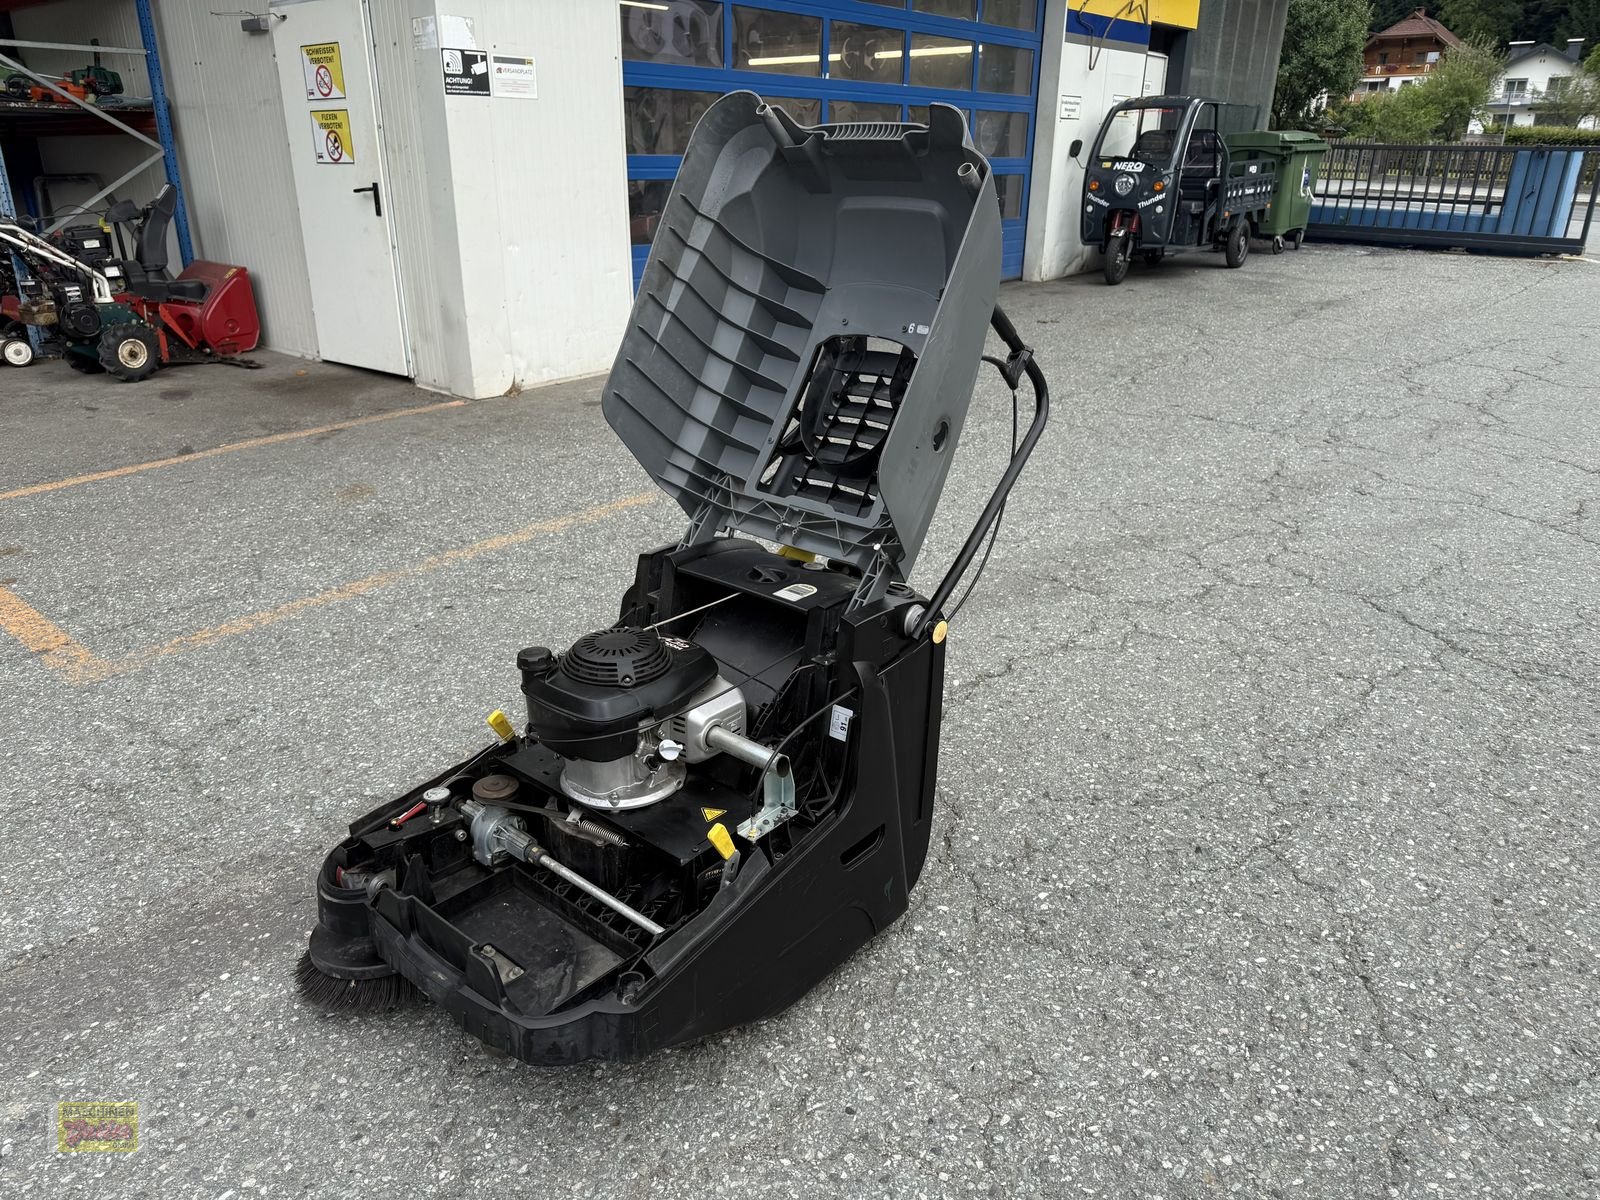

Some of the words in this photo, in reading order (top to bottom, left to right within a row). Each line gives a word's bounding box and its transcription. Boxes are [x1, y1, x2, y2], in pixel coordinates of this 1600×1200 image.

[305, 46, 335, 56] SCHWEISSEN
[309, 55, 335, 64] VERBOTEN!
[445, 77, 473, 85] ACHTUNG!
[321, 113, 338, 121] FLEXEN
[319, 122, 344, 130] VERBOTEN!
[1086, 192, 1110, 208] Thunder
[1137, 192, 1166, 209] Thunder
